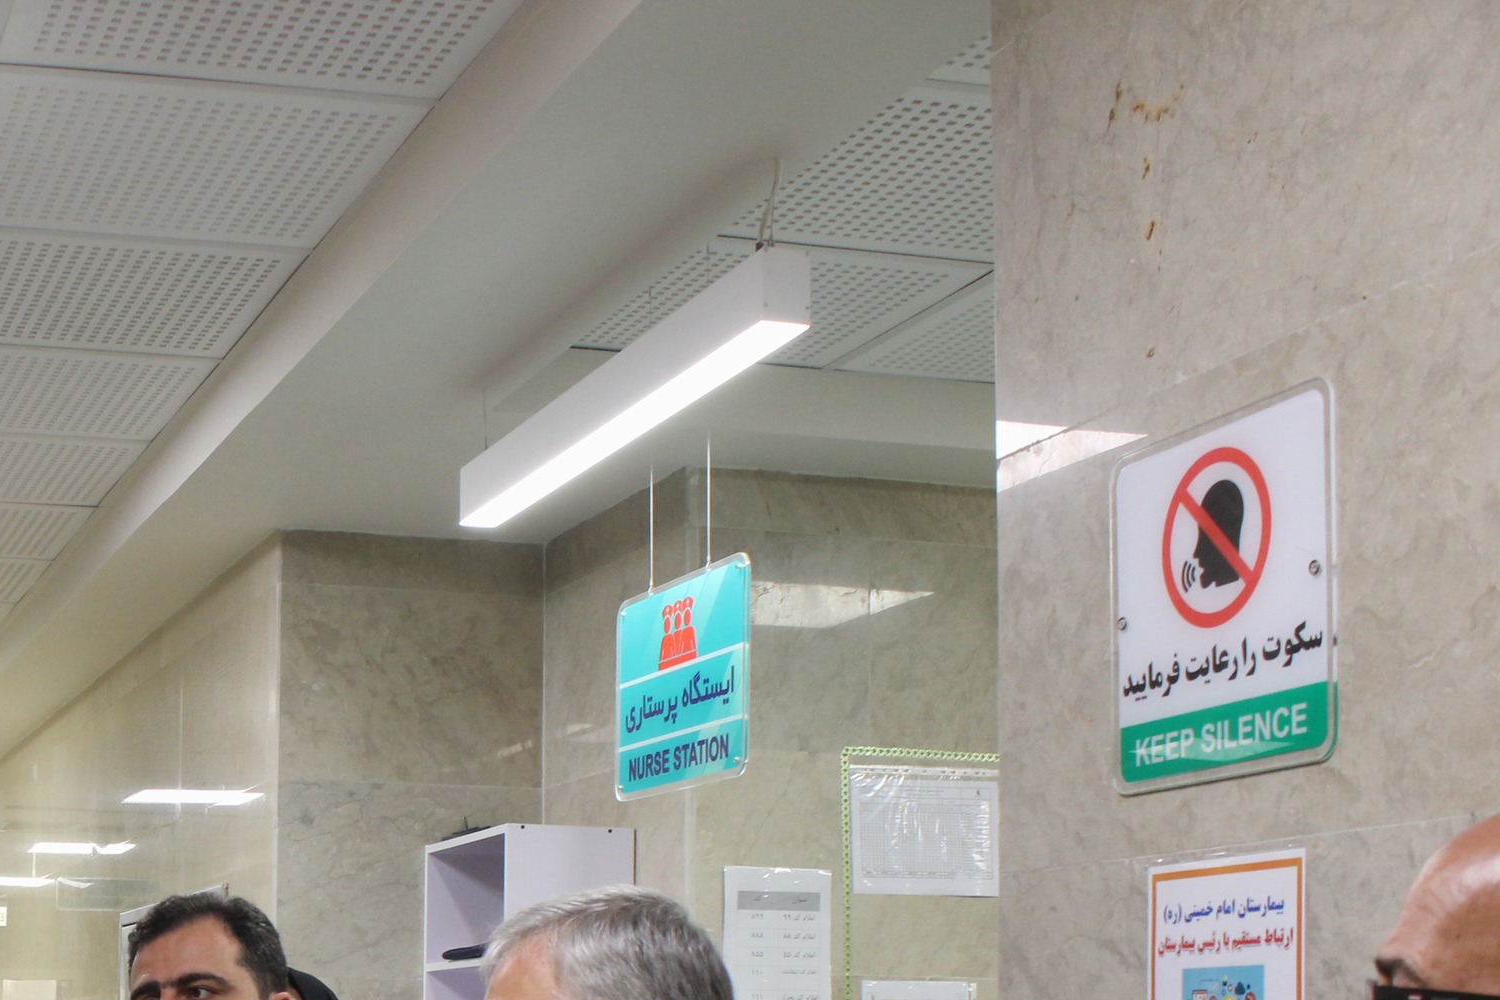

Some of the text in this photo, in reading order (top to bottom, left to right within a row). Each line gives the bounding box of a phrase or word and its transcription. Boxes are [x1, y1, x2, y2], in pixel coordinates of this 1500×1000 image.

[1123, 621, 1323, 701] سکوت را رعایت فرمایید
[626, 666, 735, 734] ایستگاه پرستاری
[628, 733, 729, 782] NURSE STATION
[1135, 702, 1308, 767] KEEP SILENCE
[1164, 895, 1284, 924] بیمارستان امام خمینی (ره)
[1158, 927, 1293, 956] ارتباط مستقیم با رئیس بیمارستان
